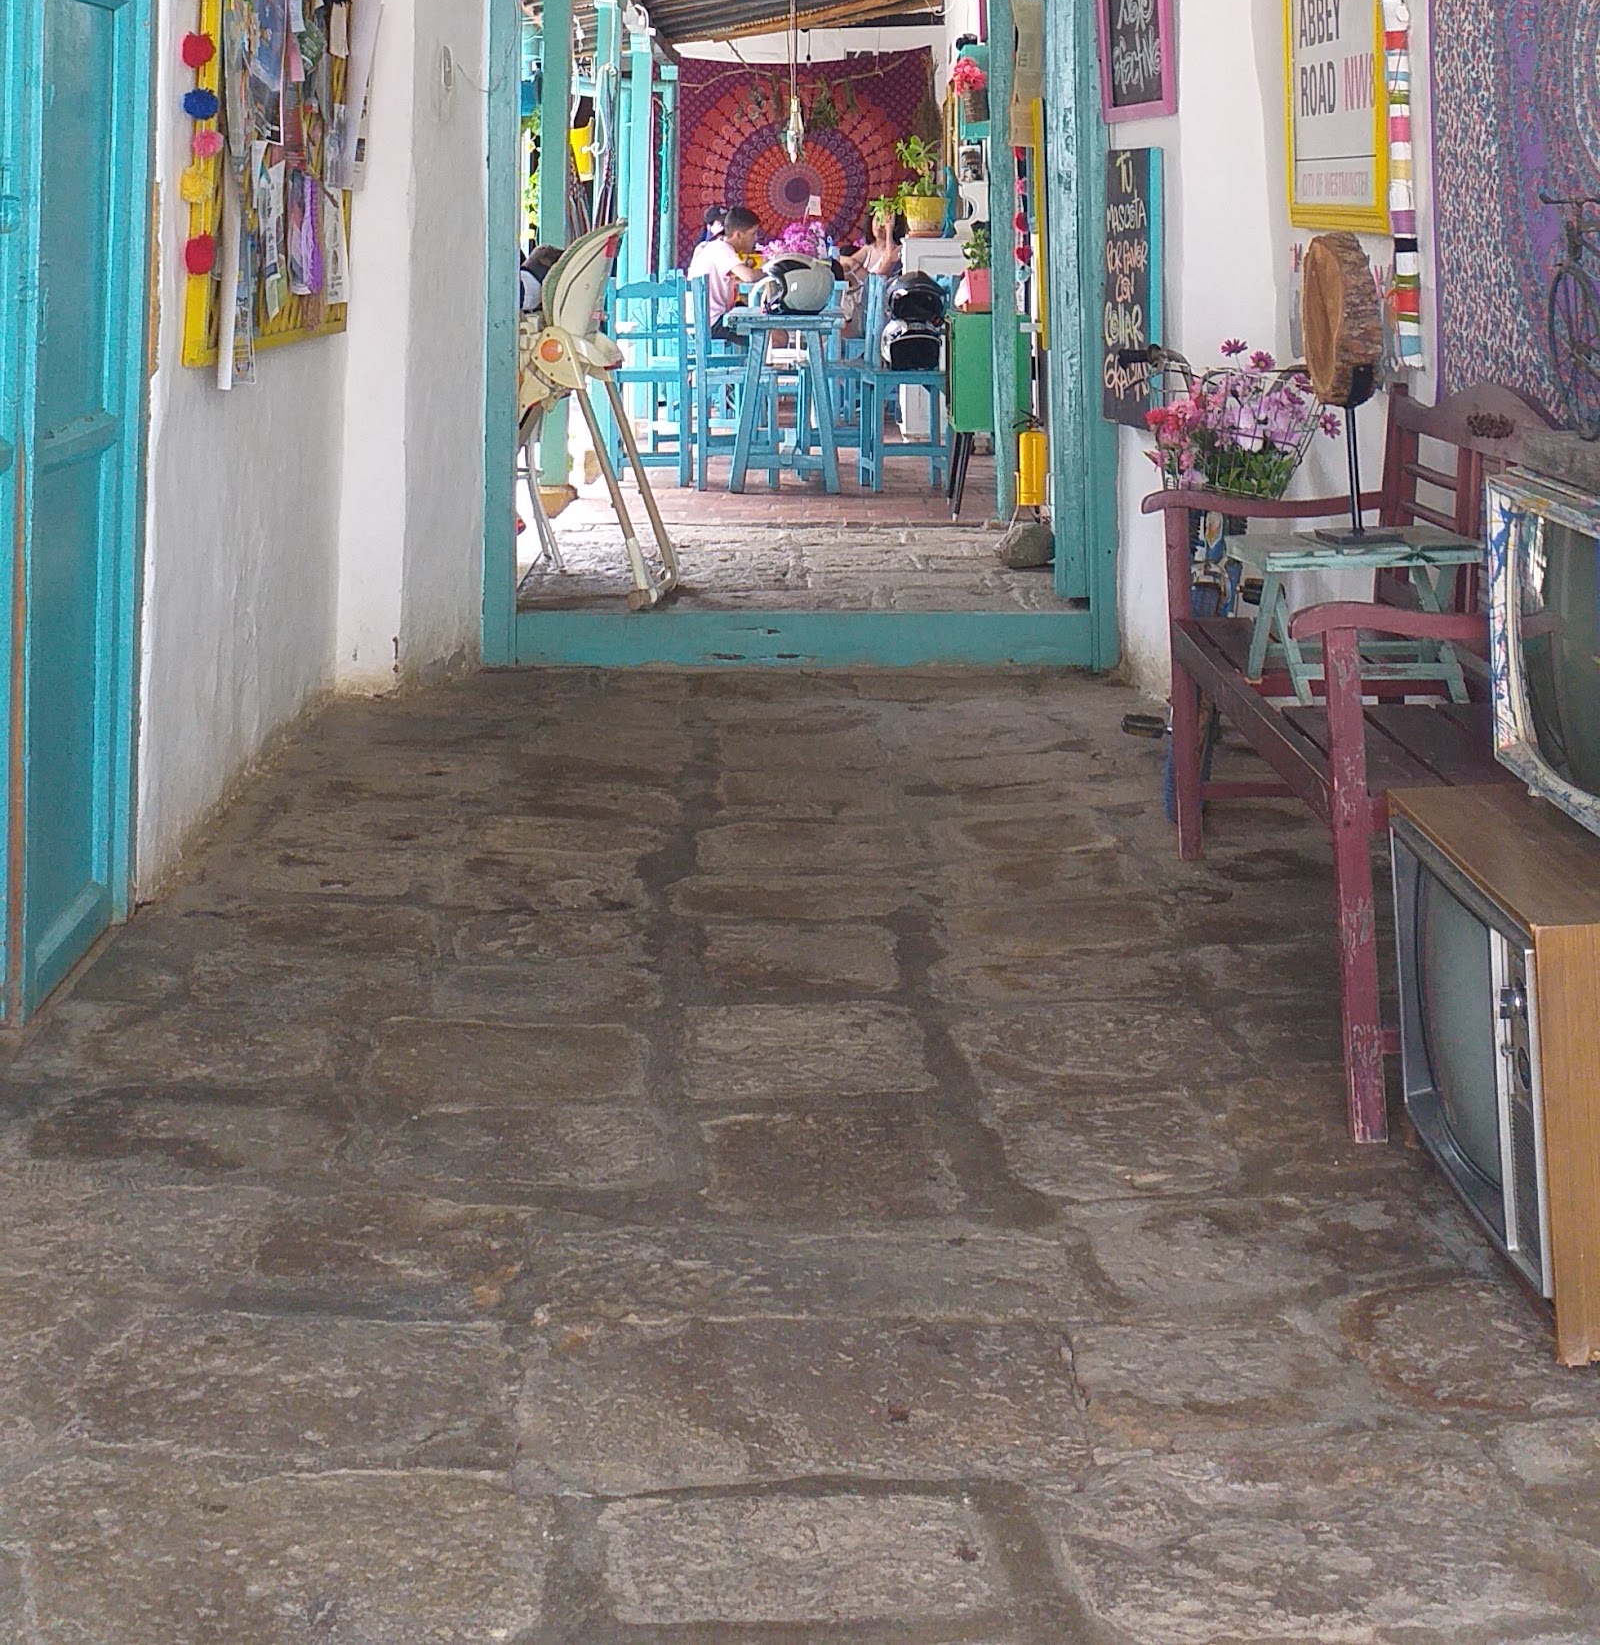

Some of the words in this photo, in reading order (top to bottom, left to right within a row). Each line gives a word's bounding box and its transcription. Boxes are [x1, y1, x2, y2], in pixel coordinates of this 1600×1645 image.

[1301, 60, 1336, 117] ROAD
[1343, 52, 1375, 111] NW8
[1115, 150, 1133, 194] TU
[1106, 189, 1148, 236] MASCOTA
[1106, 239, 1123, 274] POR
[1123, 238, 1149, 274] FAVOR
